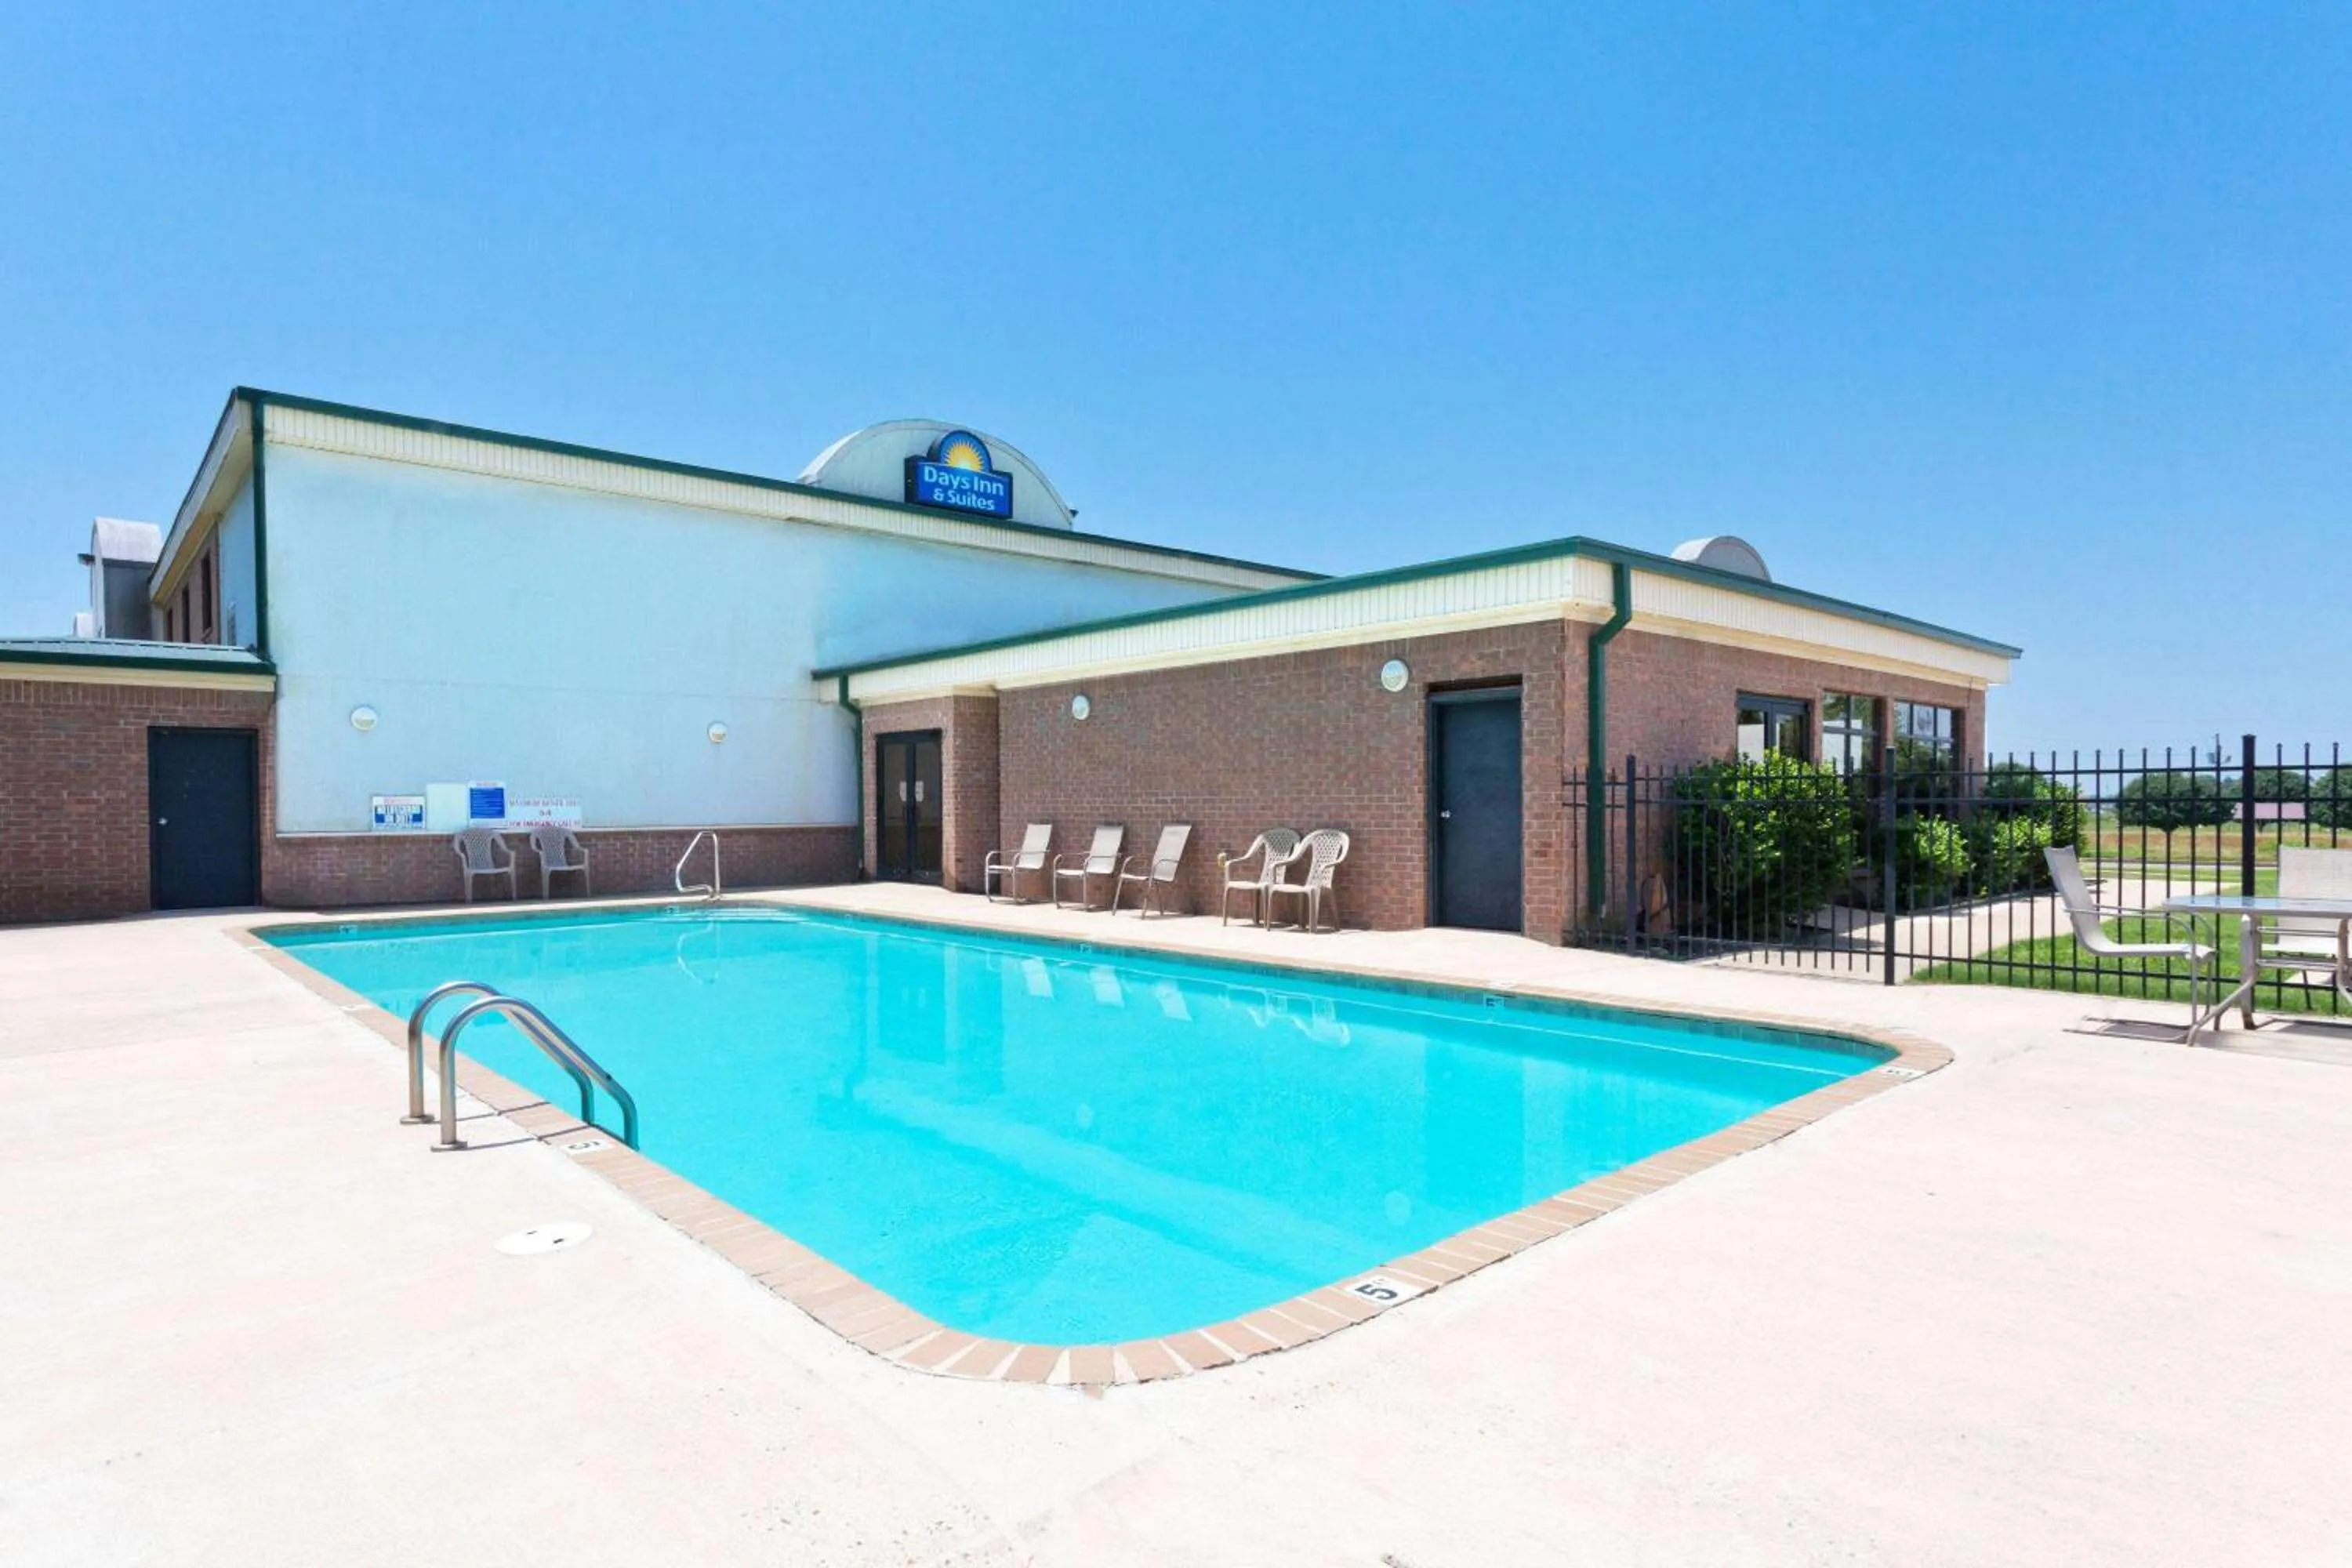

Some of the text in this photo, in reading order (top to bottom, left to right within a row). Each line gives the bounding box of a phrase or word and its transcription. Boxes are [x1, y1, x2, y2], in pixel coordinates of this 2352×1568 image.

[924, 466, 1004, 496] Days Inn
[933, 488, 996, 510] & Suites
[1354, 1283, 1399, 1301] 5
